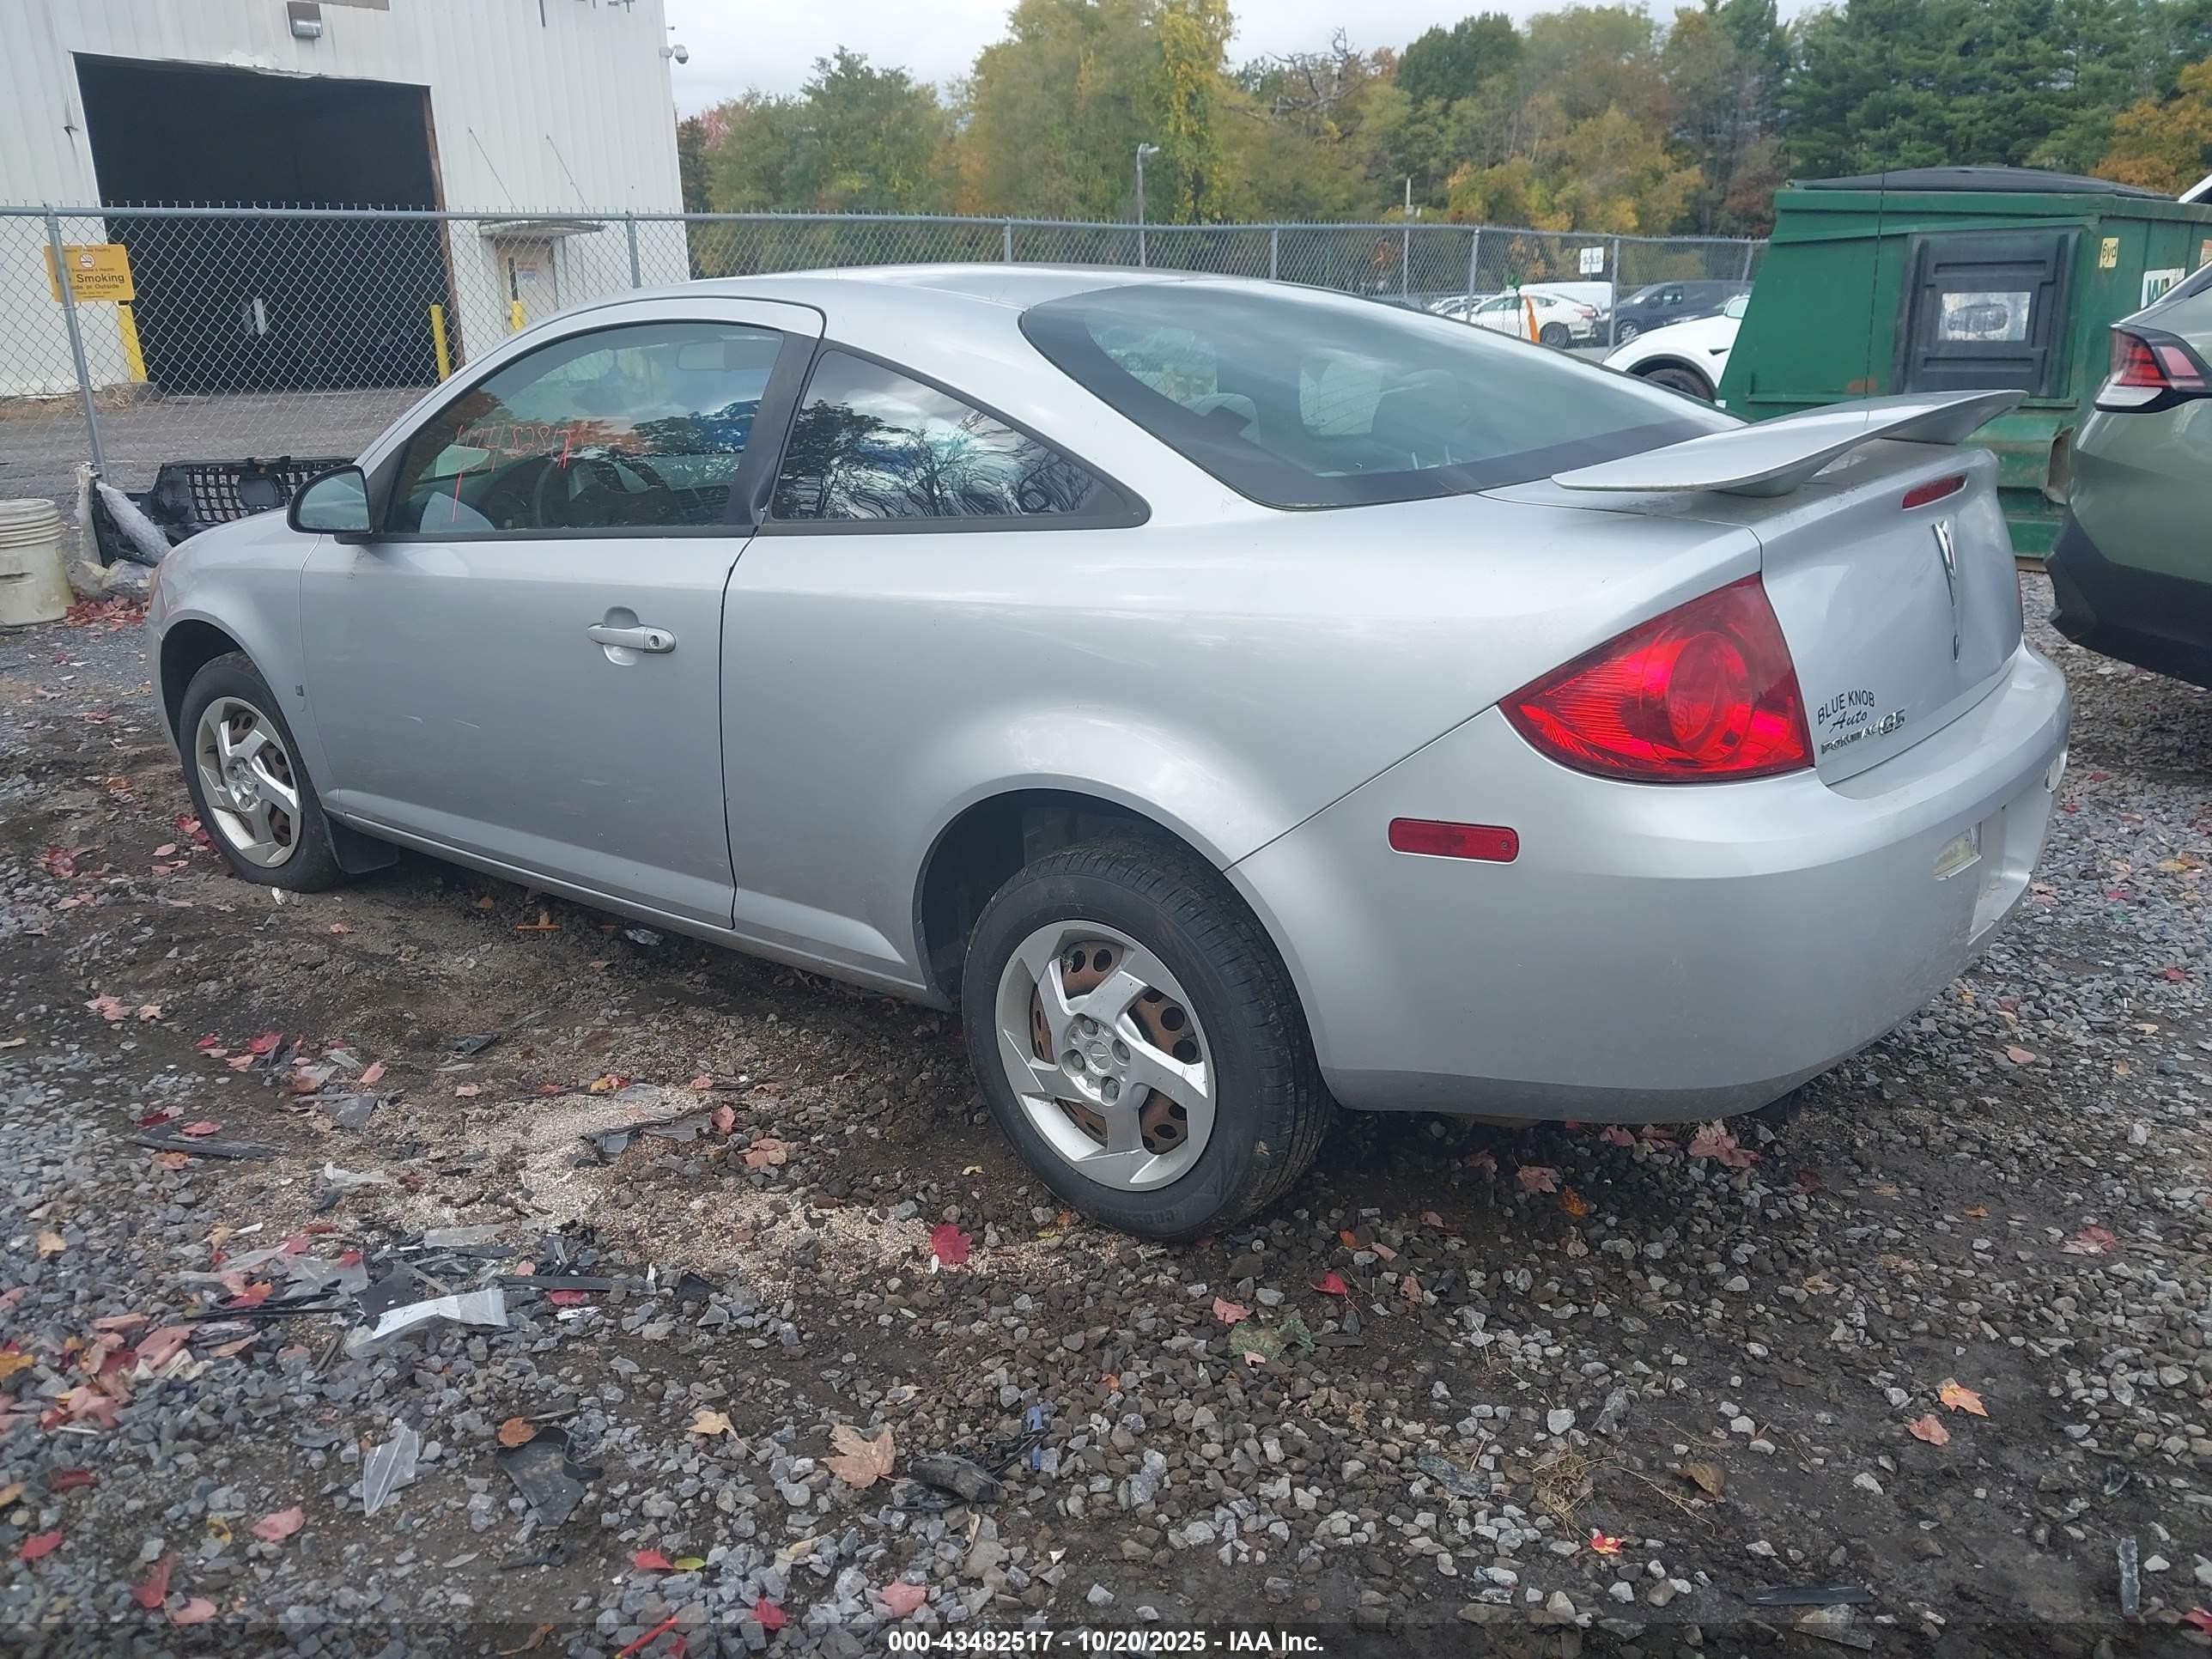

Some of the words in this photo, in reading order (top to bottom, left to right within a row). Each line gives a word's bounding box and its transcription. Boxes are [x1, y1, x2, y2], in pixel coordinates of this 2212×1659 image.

[76, 273, 125, 283] Smoking
[1817, 693, 1846, 726] BLUE
[1848, 690, 1875, 708] KNOB
[1829, 709, 1868, 733] Auto
[1878, 708, 1905, 736] G5
